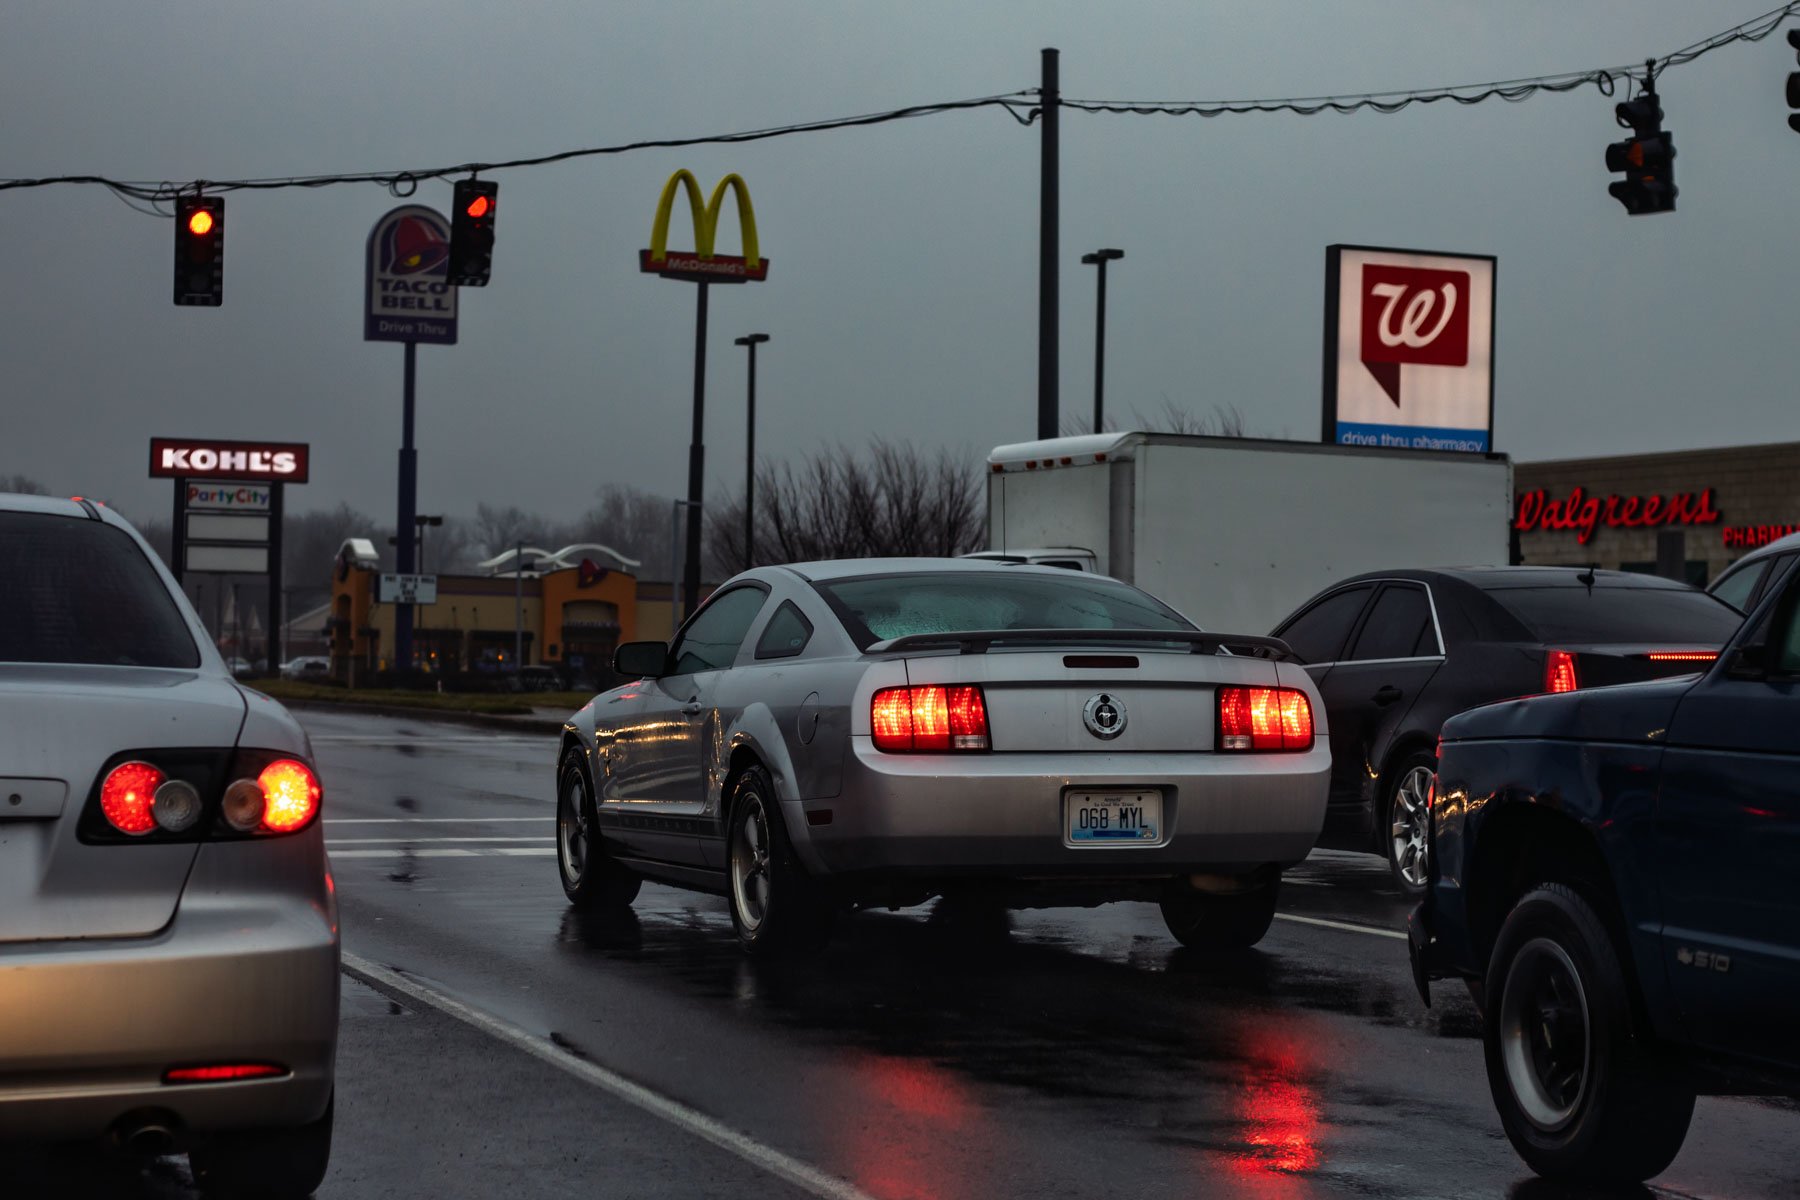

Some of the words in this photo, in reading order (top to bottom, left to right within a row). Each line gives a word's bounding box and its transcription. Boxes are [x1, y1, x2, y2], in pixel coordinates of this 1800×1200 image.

[667, 258, 745, 274] McDonald's
[377, 278, 449, 294] TACO
[381, 295, 449, 311] BELL
[379, 320, 414, 334] Drive
[417, 322, 447, 335] Thru
[1342, 431, 1378, 446] drive
[1381, 433, 1409, 448] thru
[1412, 435, 1483, 452] pharmacy
[162, 447, 297, 473] KOHL'S
[1515, 487, 1720, 545] Walgreens
[1079, 808, 1108, 829] 068
[1119, 807, 1148, 828] MYL
